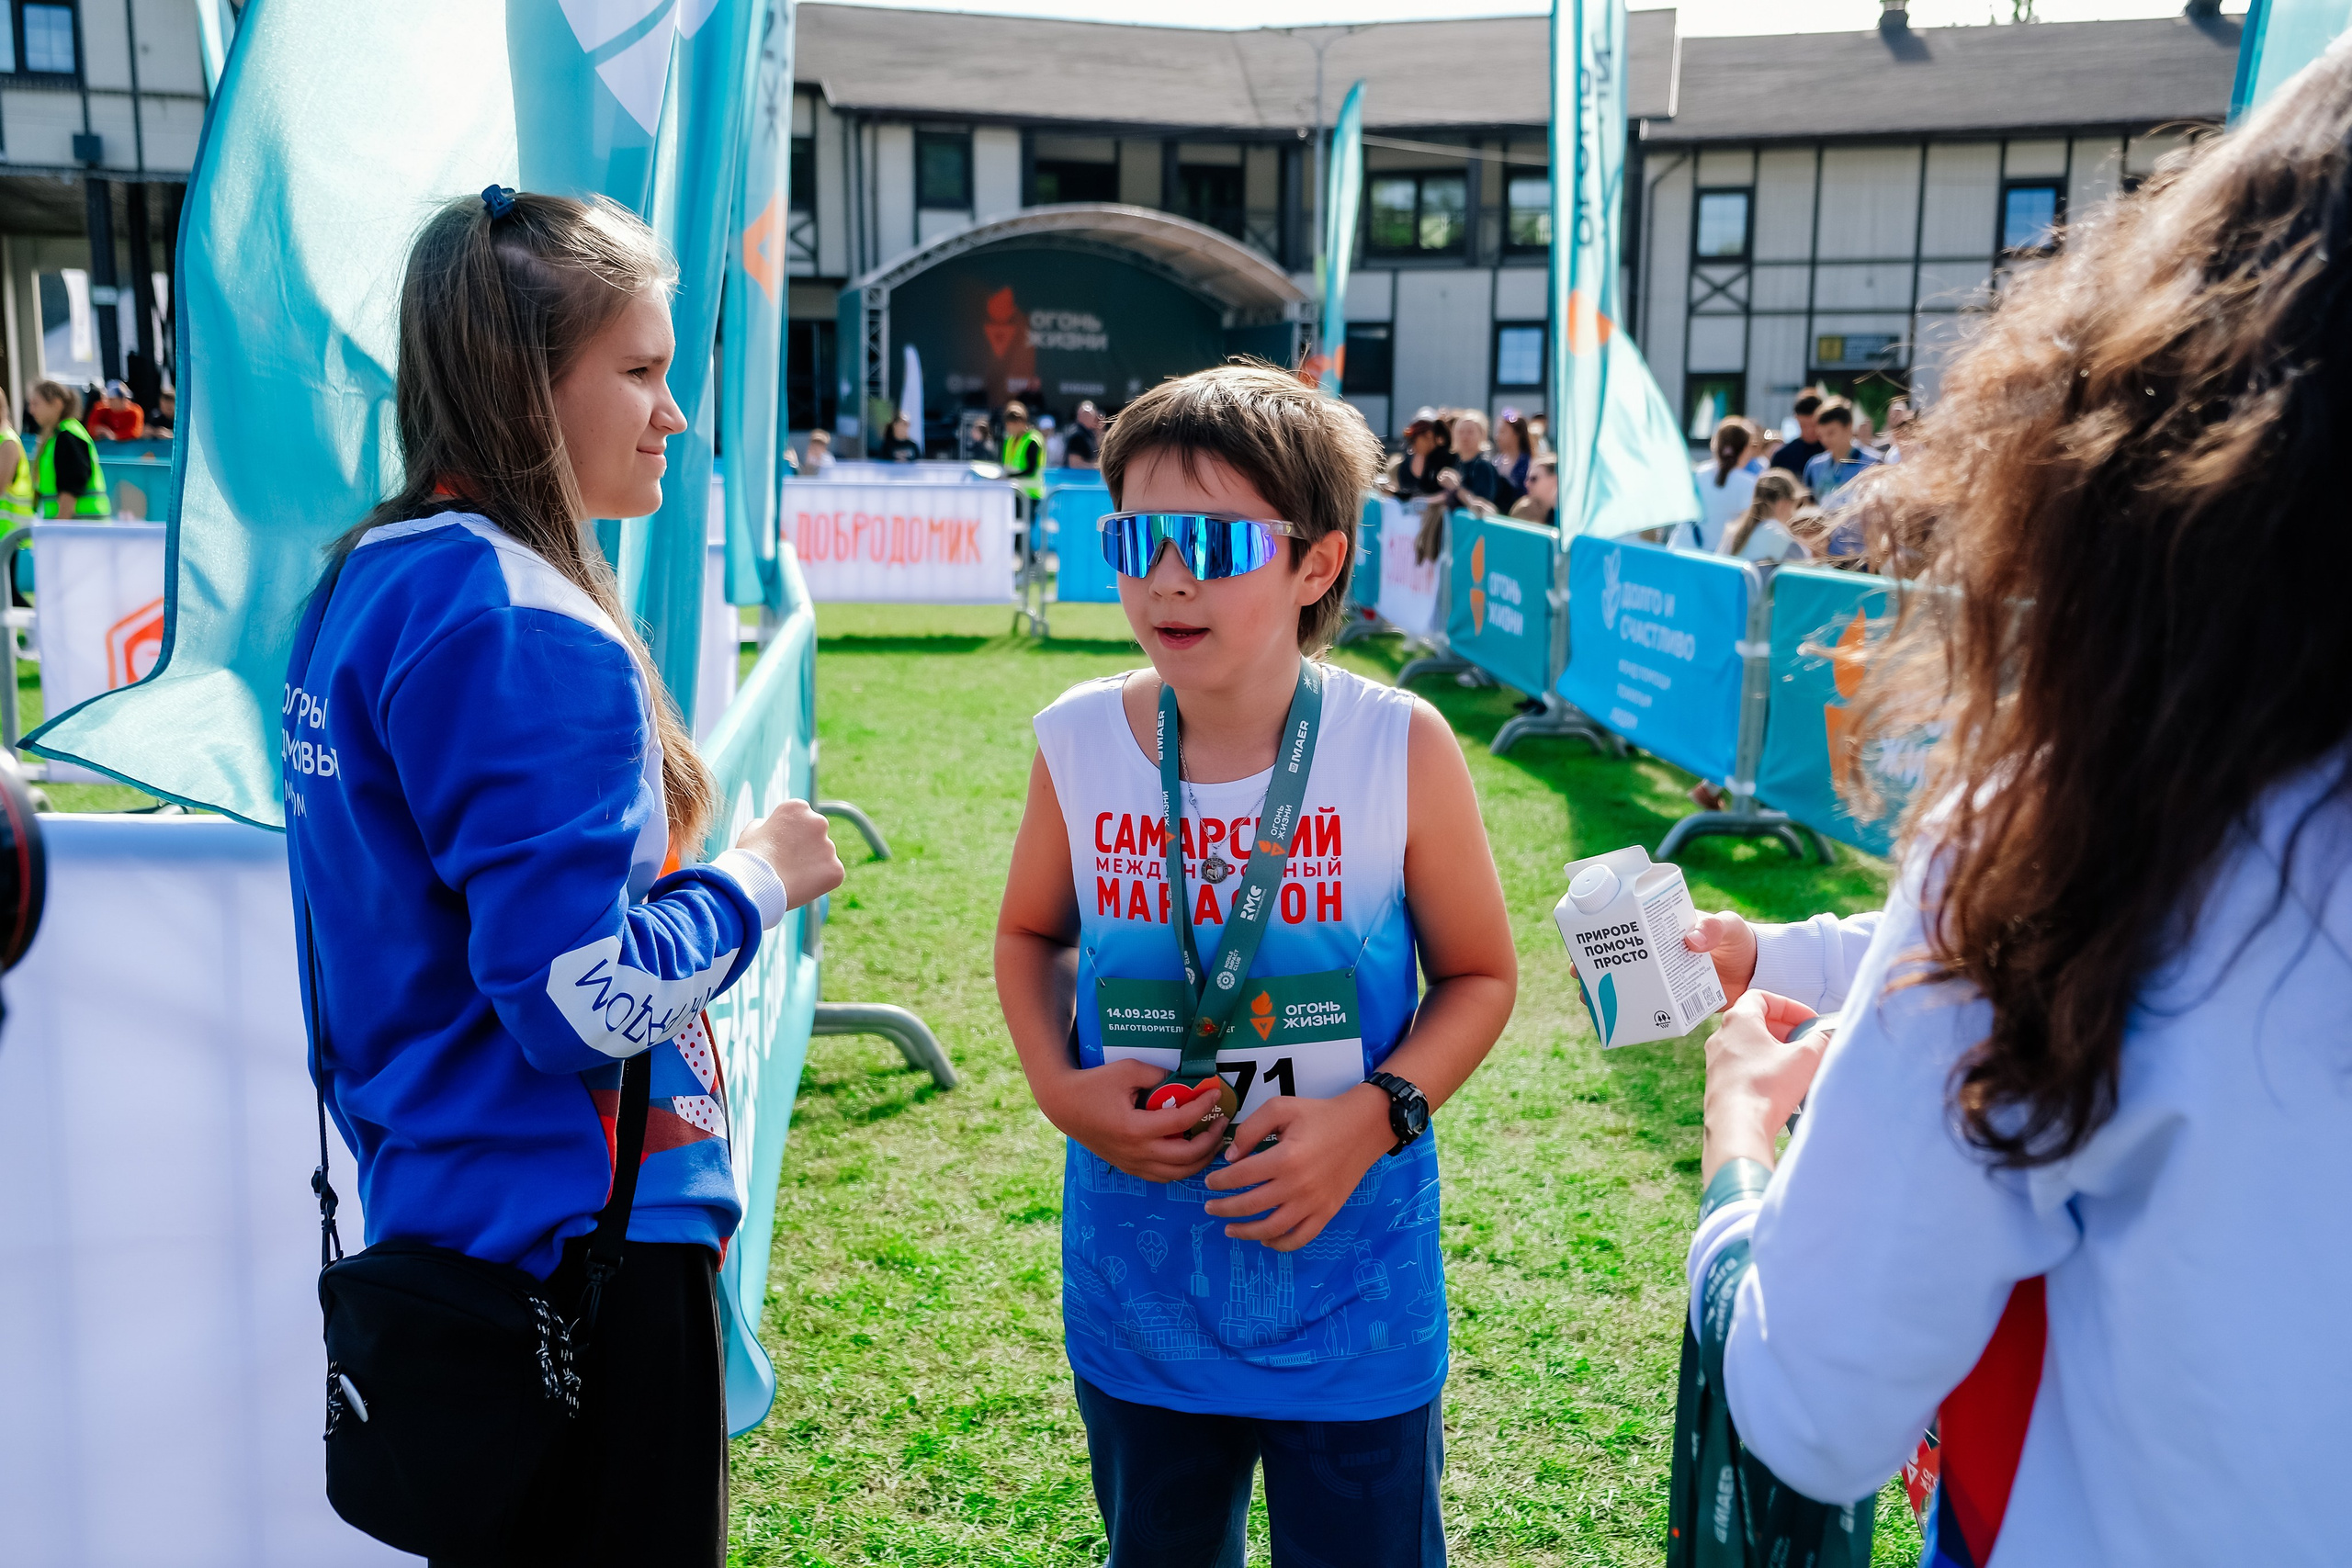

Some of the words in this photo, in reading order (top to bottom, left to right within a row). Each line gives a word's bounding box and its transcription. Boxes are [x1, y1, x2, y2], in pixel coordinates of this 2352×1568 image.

[796, 512, 982, 570] ДОБРОДОМИК
[1487, 570, 1522, 605] ОГОНЬ
[1487, 601, 1523, 637] ЖИЗНИ
[1619, 614, 1696, 661] СЧАСТЛИВО
[1157, 710, 1166, 750] MAER
[1291, 720, 1309, 762] MAER
[1162, 791, 1170, 827] ЖИЗНИ
[1271, 805, 1284, 836] ОГОНЬ
[1277, 804, 1293, 840] ЖИЗНИ
[1094, 806, 1342, 860] САМАРСИЙ
[1240, 885, 1262, 921] RMG
[1224, 951, 1234, 968] NOBLE
[1228, 949, 1239, 970] IMPACT
[1584, 936, 1645, 957] ПОМОЧЬ
[1593, 949, 1648, 969] ПРОСТО
[1232, 957, 1241, 971] CLUB
[1106, 1008, 1176, 1020] 14.09.2025
[1283, 1012, 1347, 1030] ЖИЗНИ
[1285, 1000, 1341, 1016] ОГОНЬ
[1108, 1023, 1183, 1033] БЛАГОТВОРИТЕЛ
